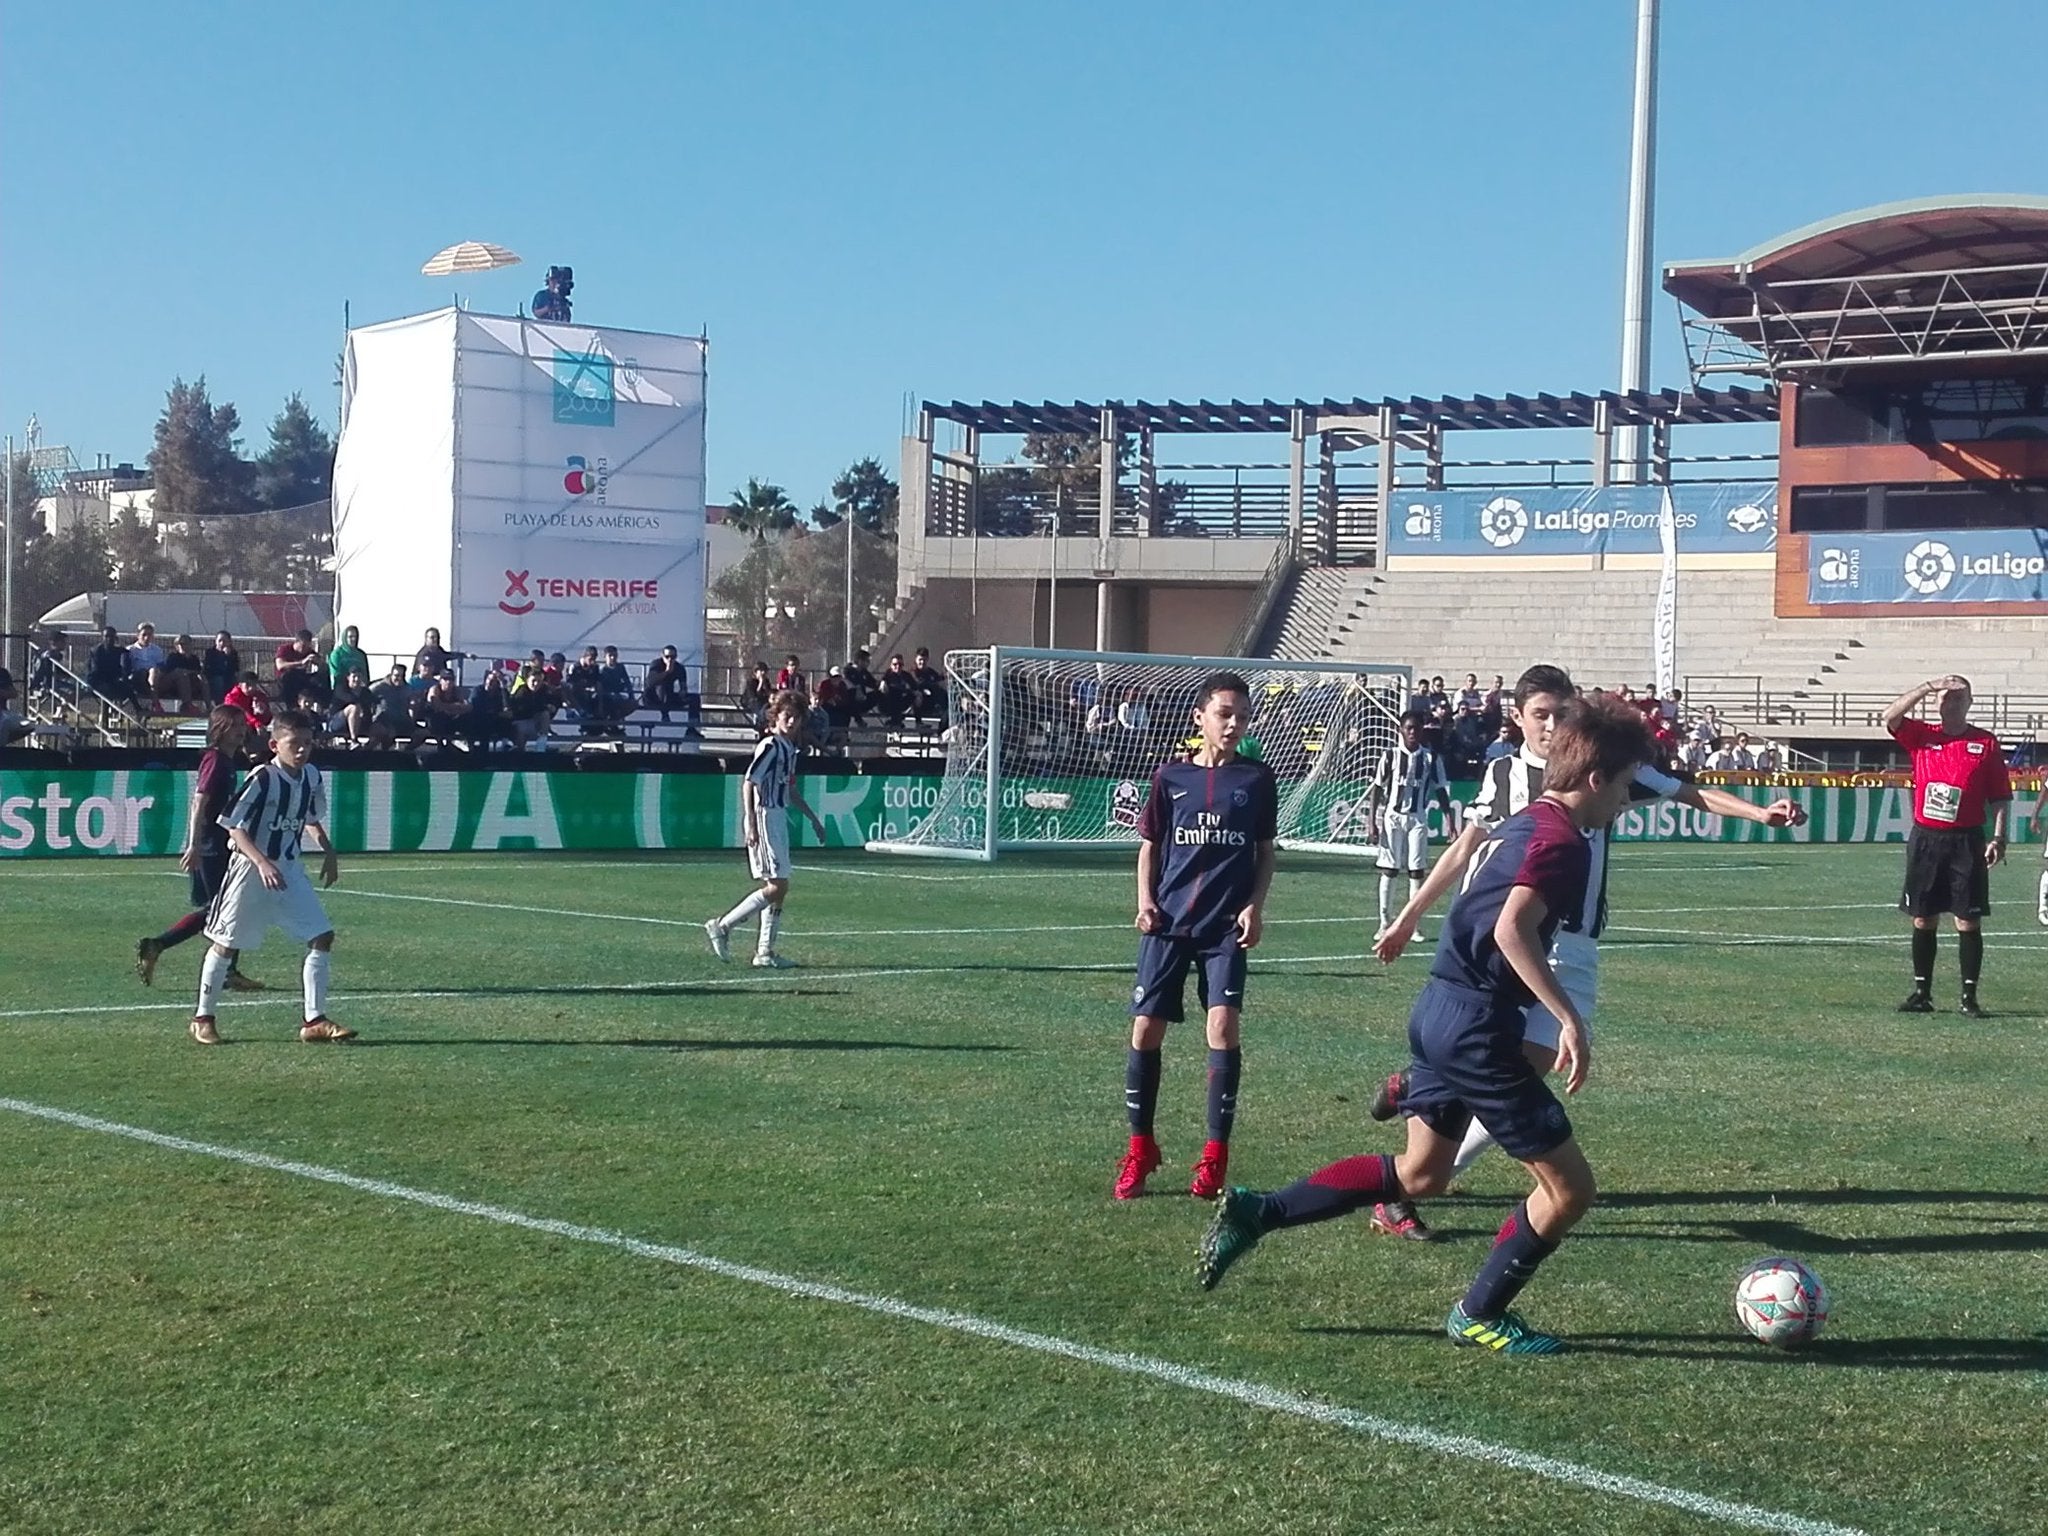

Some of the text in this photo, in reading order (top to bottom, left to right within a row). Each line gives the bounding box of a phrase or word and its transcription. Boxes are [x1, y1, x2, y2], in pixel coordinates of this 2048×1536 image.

[504, 512, 661, 530] PLAYA DE LAS AMÉRICAS
[1534, 507, 1698, 533] LaLiga Promes
[1962, 551, 2046, 579] LaLiga
[536, 578, 659, 599] TENERIFE
[634, 602, 658, 615] VIDA
[1197, 812, 1221, 828] Fly
[1174, 825, 1246, 846] Emirates
